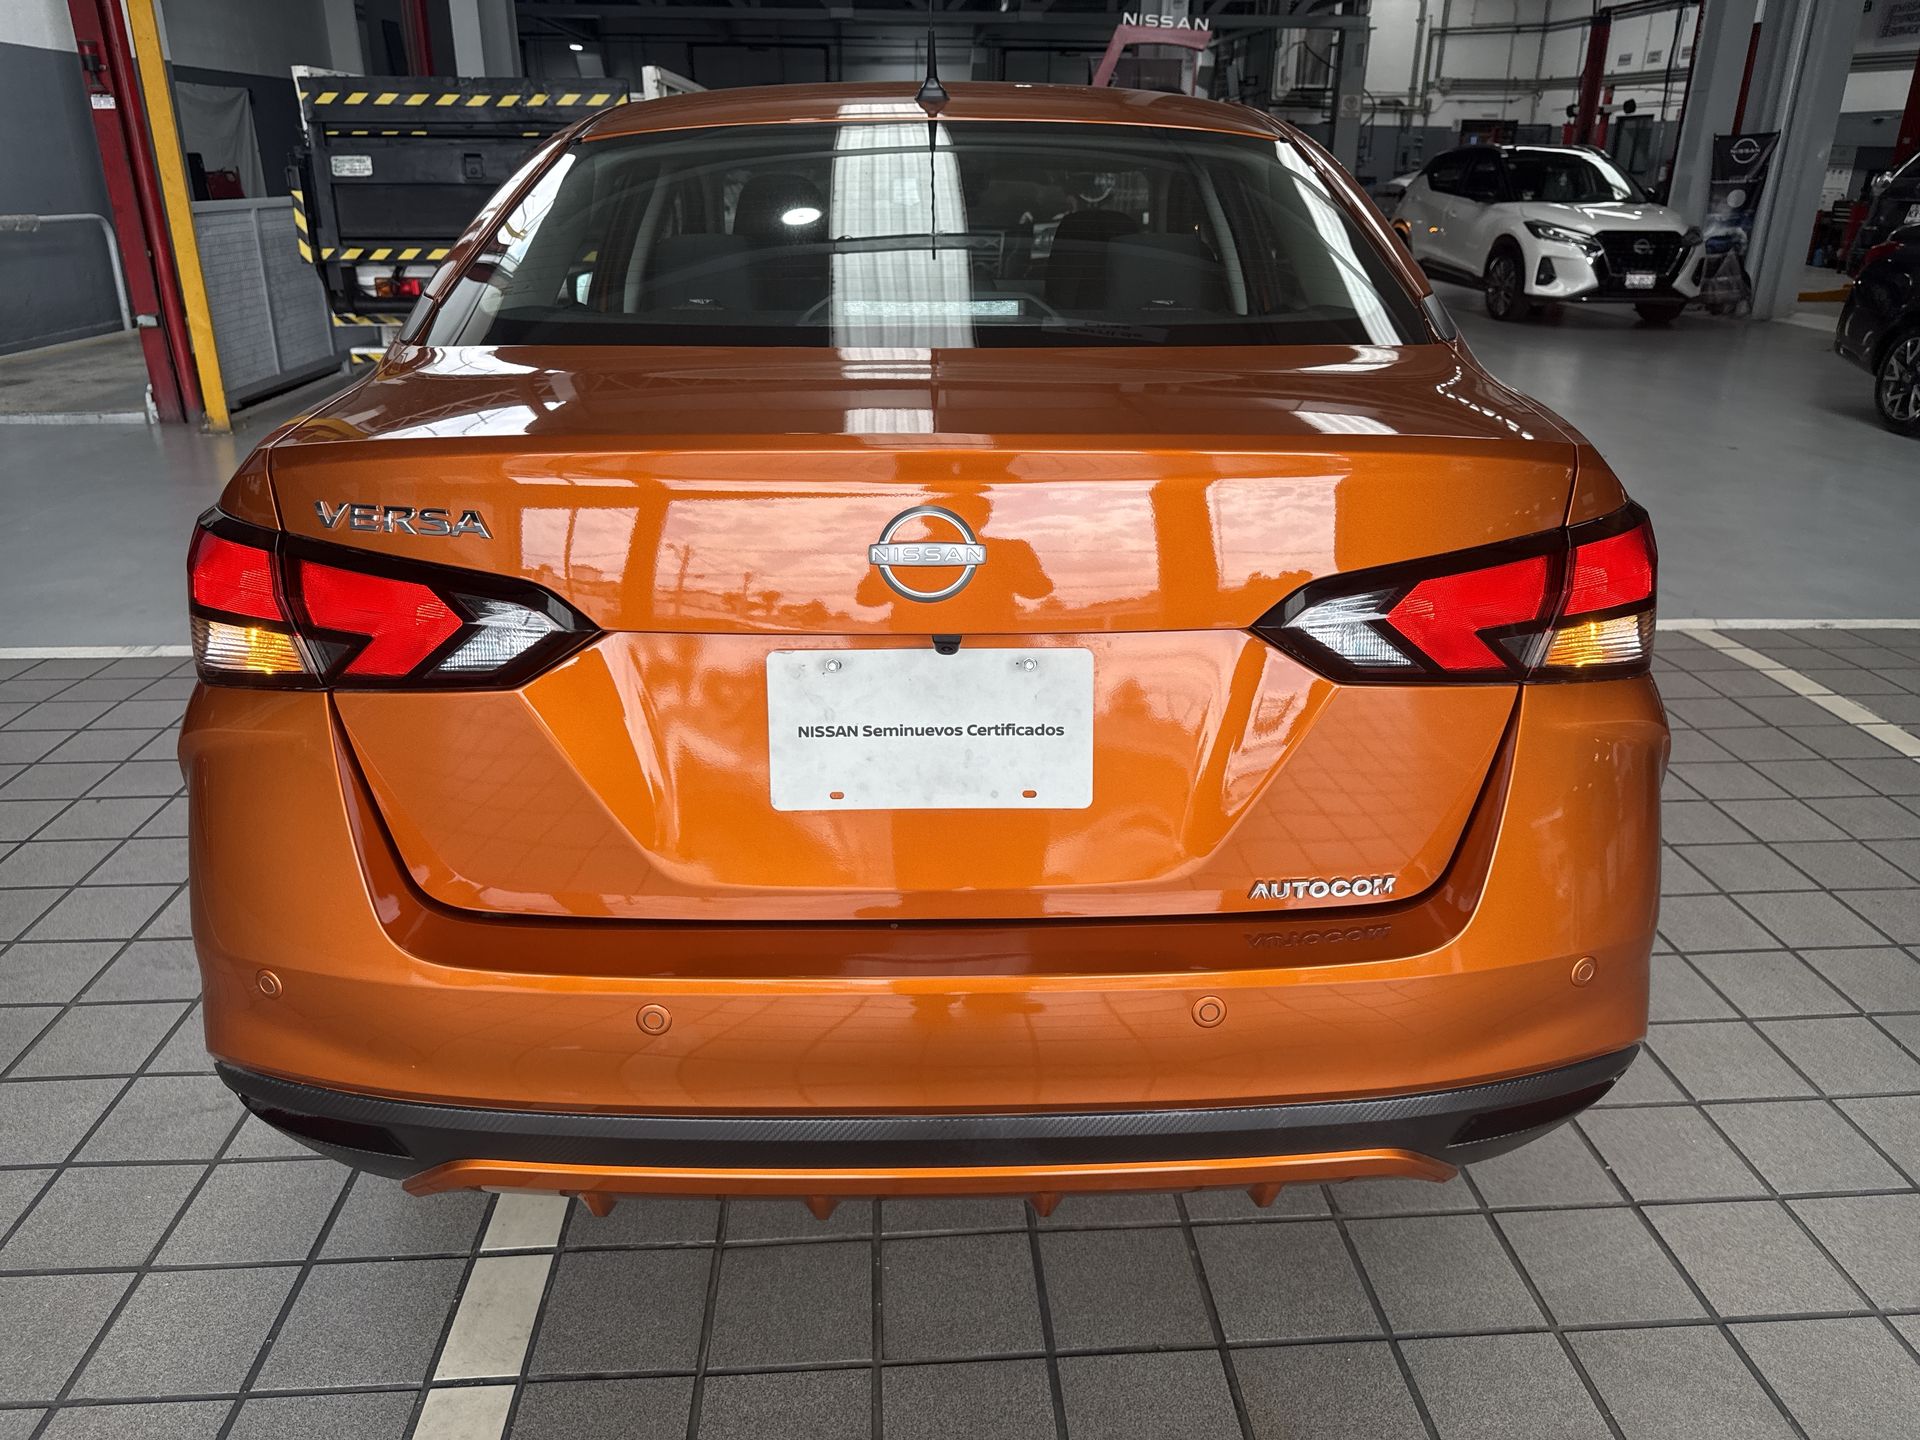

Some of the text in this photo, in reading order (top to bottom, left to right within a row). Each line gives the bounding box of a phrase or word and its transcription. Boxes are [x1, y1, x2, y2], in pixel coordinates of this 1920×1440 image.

[1122, 12, 1210, 31] NISSAN
[314, 500, 494, 540] VERSA
[871, 547, 984, 562] NISSAN
[797, 723, 1065, 738] NISSAN Seminuevos Certificados
[1248, 876, 1397, 899] AUTOCOM
